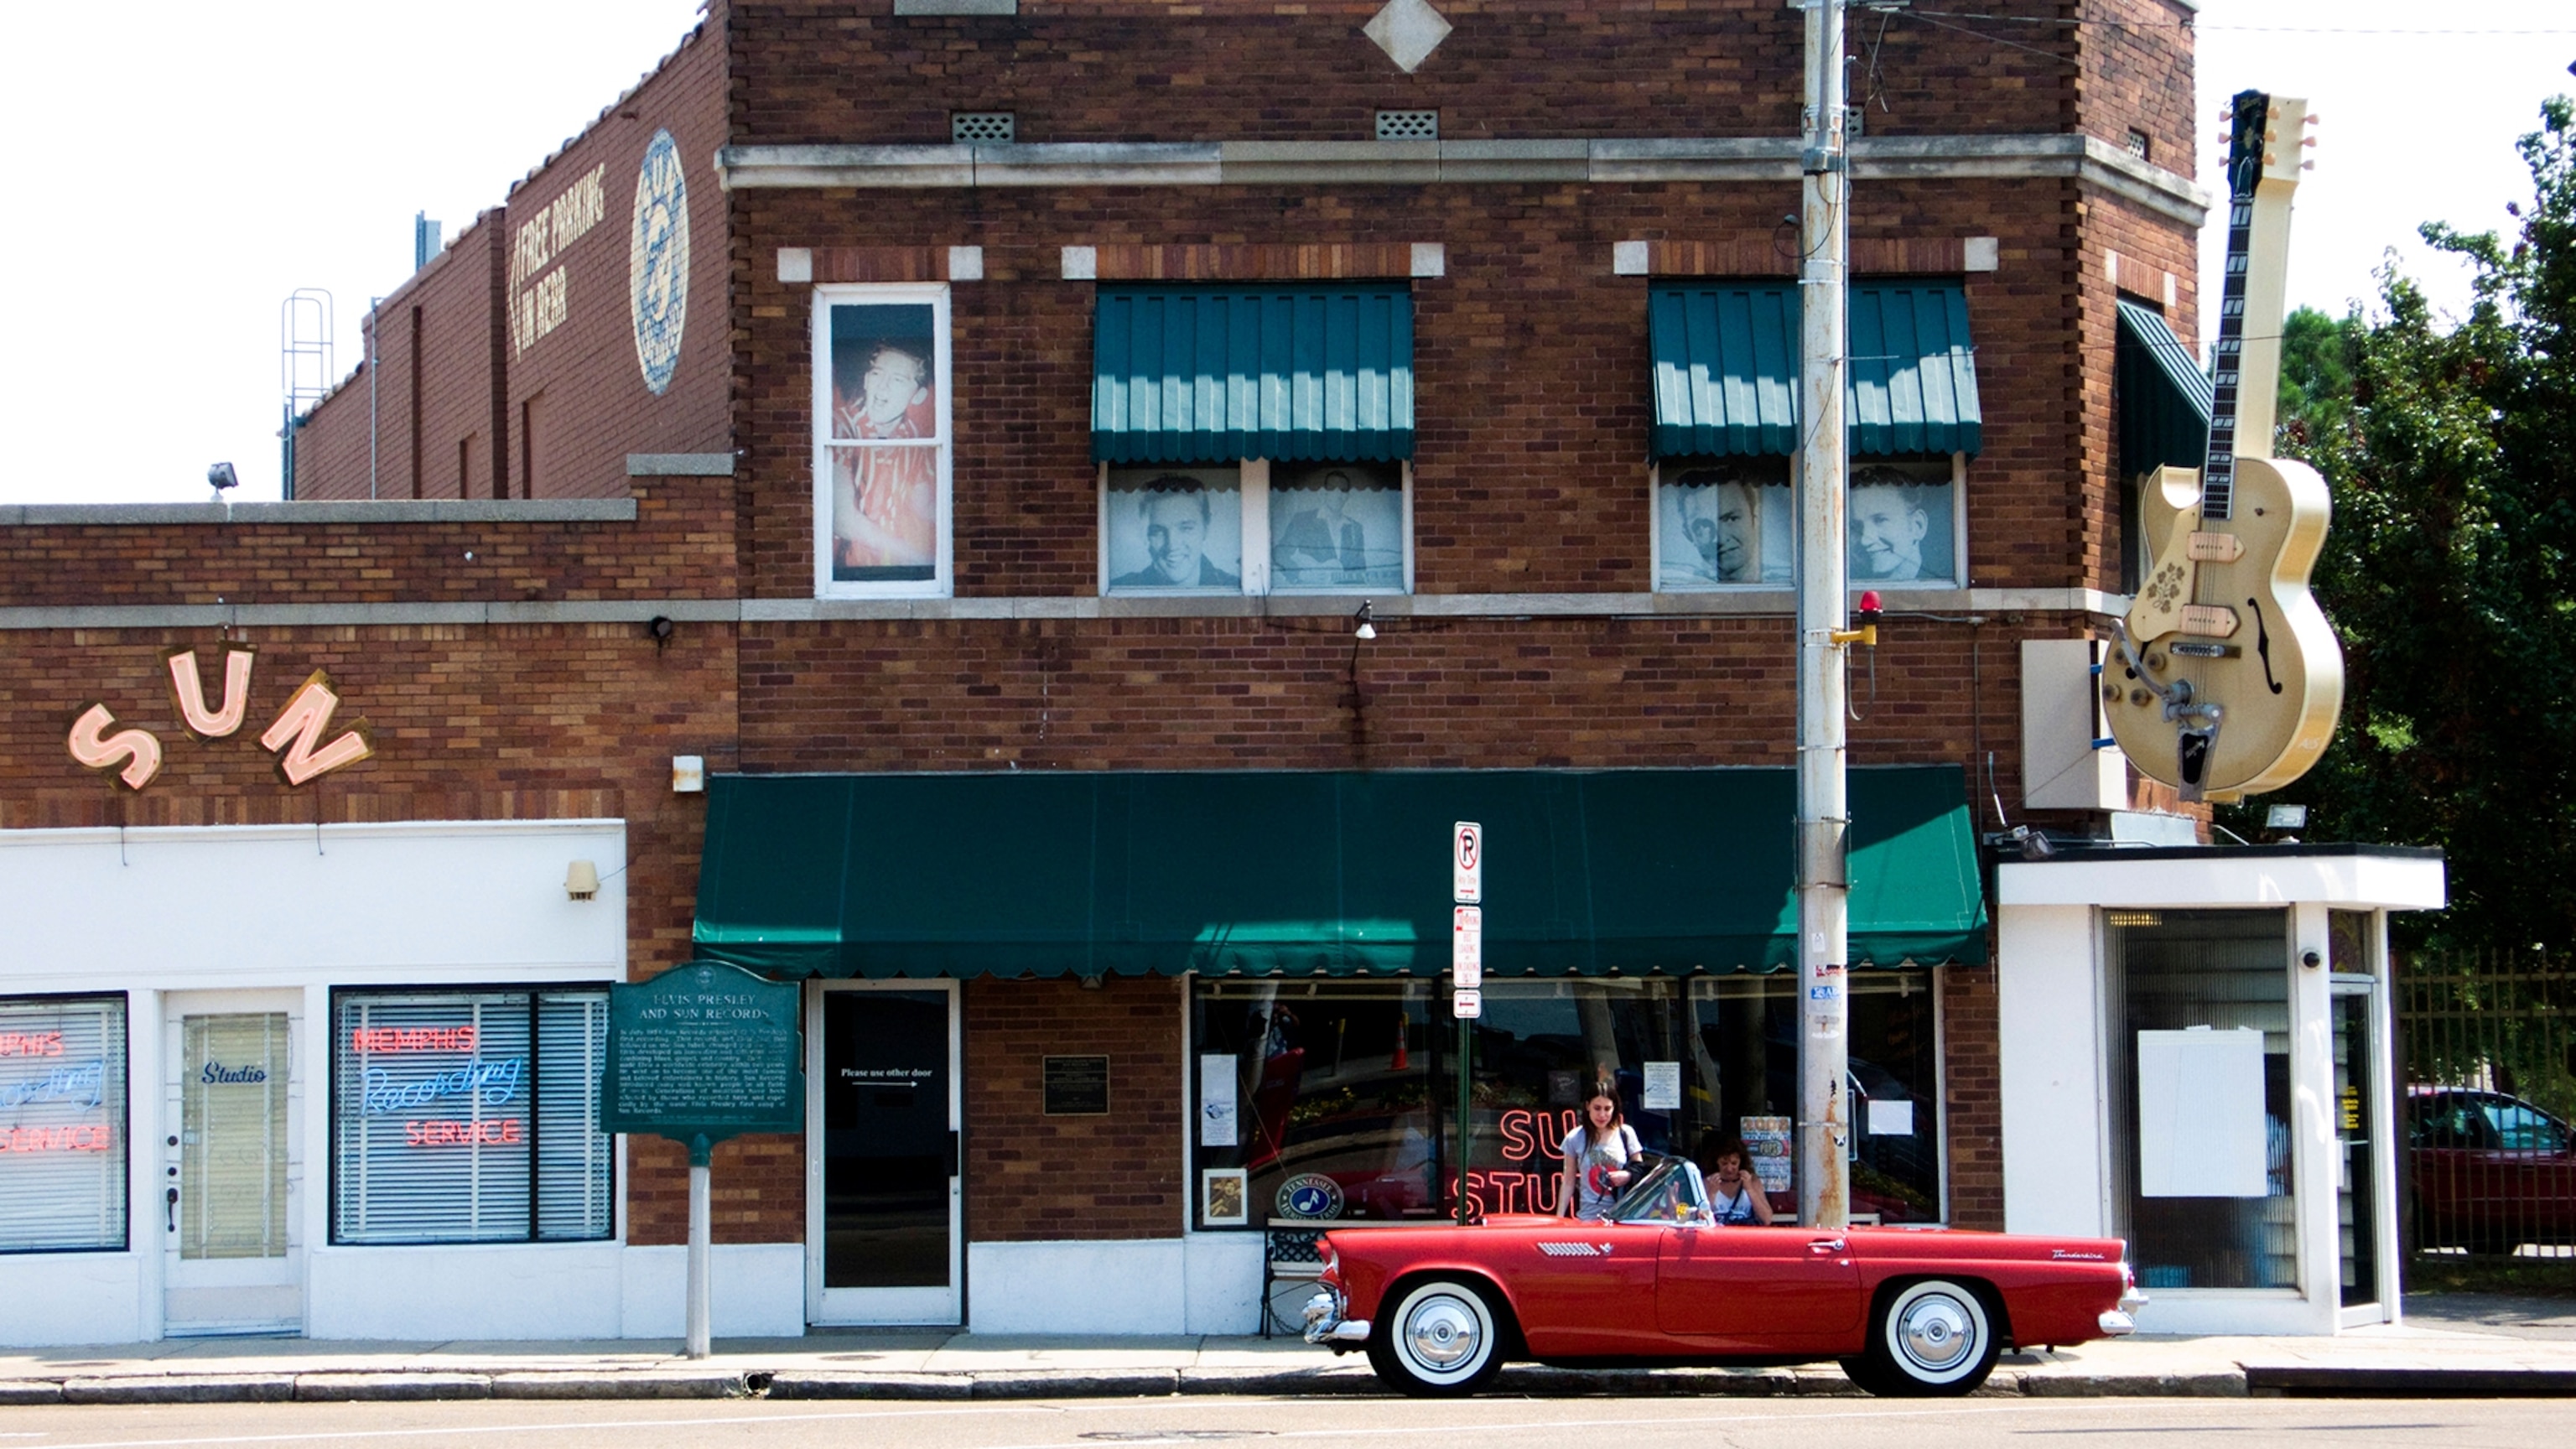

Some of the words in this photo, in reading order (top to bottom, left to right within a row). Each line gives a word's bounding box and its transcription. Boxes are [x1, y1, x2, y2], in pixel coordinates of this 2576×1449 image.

[521, 206, 550, 282] FREE
[552, 162, 605, 257] PARKING
[522, 288, 535, 351] IN
[537, 264, 567, 340] REAR
[67, 647, 370, 791] SUN
[654, 995, 690, 1005] ELVIS
[698, 994, 756, 1005] PRESLEY
[640, 1009, 667, 1020] AND
[673, 1009, 699, 1019] SUN
[706, 1009, 769, 1019] RECORDS
[0, 1031, 64, 1057] PHIS
[353, 1026, 476, 1052] MEMPHIS
[202, 1062, 267, 1083] Studio
[361, 1055, 523, 1116] Recording
[841, 1068, 868, 1078] Please
[886, 1067, 911, 1078] other
[911, 1068, 933, 1078] door
[0, 1060, 105, 1112] ording
[405, 1119, 521, 1146] SERVICE
[1500, 1109, 1623, 1161] SU
[1285, 1177, 1332, 1194] TENNESSEE
[1451, 1171, 1581, 1218] STU
[2052, 1249, 2106, 1259] Thunderbird
